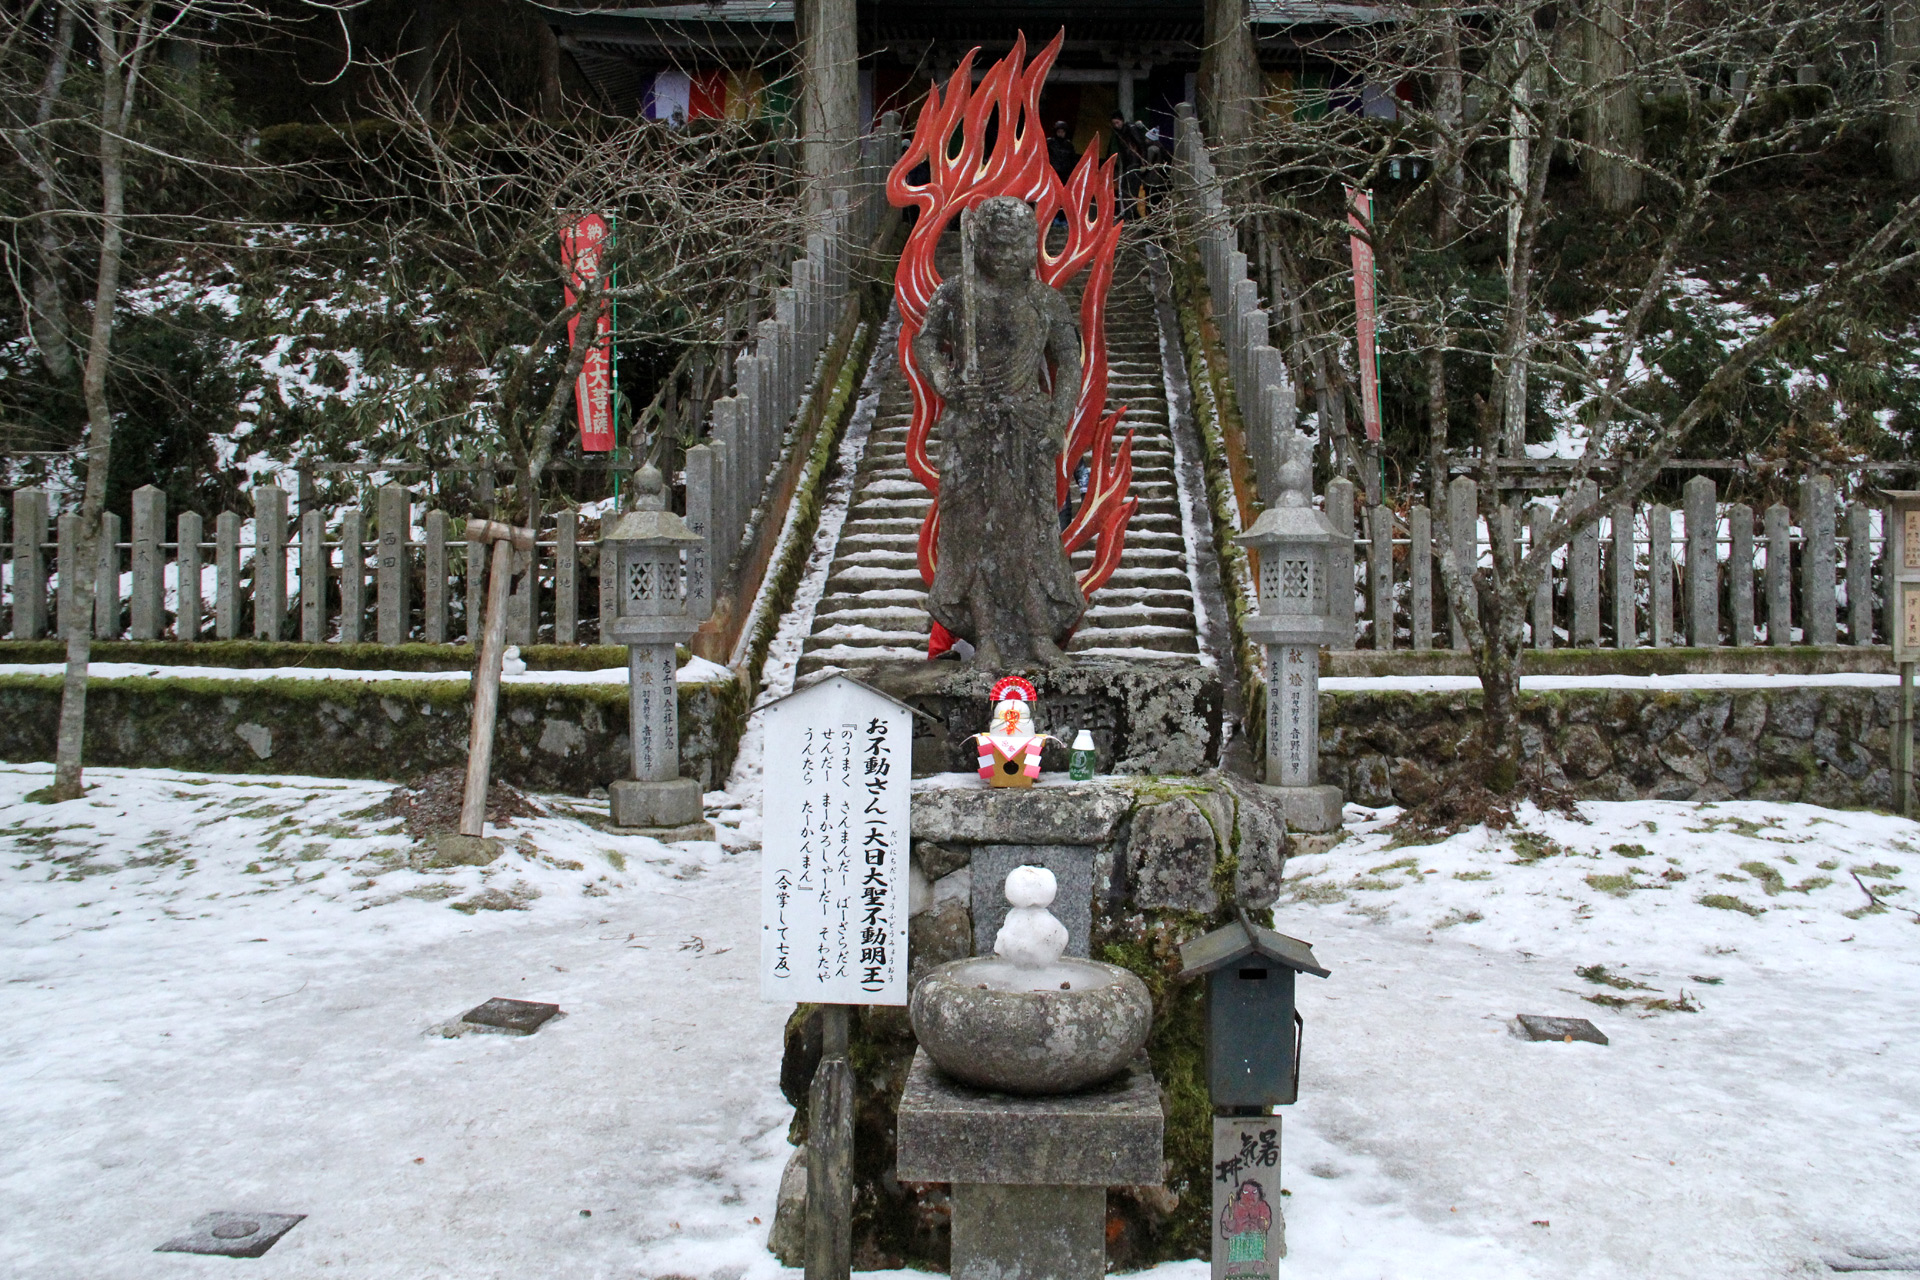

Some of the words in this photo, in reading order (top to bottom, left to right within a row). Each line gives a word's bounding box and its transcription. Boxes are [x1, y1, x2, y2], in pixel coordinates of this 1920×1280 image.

[567, 224, 603, 240] 奉納
[576, 246, 609, 434] 役変大菩薩
[1288, 649, 1304, 688] 献燈
[801, 727, 816, 786] うんたら
[820, 727, 836, 782] せんだー
[836, 800, 852, 888] さんまんだー
[816, 926, 832, 984] そわたや
[834, 896, 853, 978] ばーざらだん
